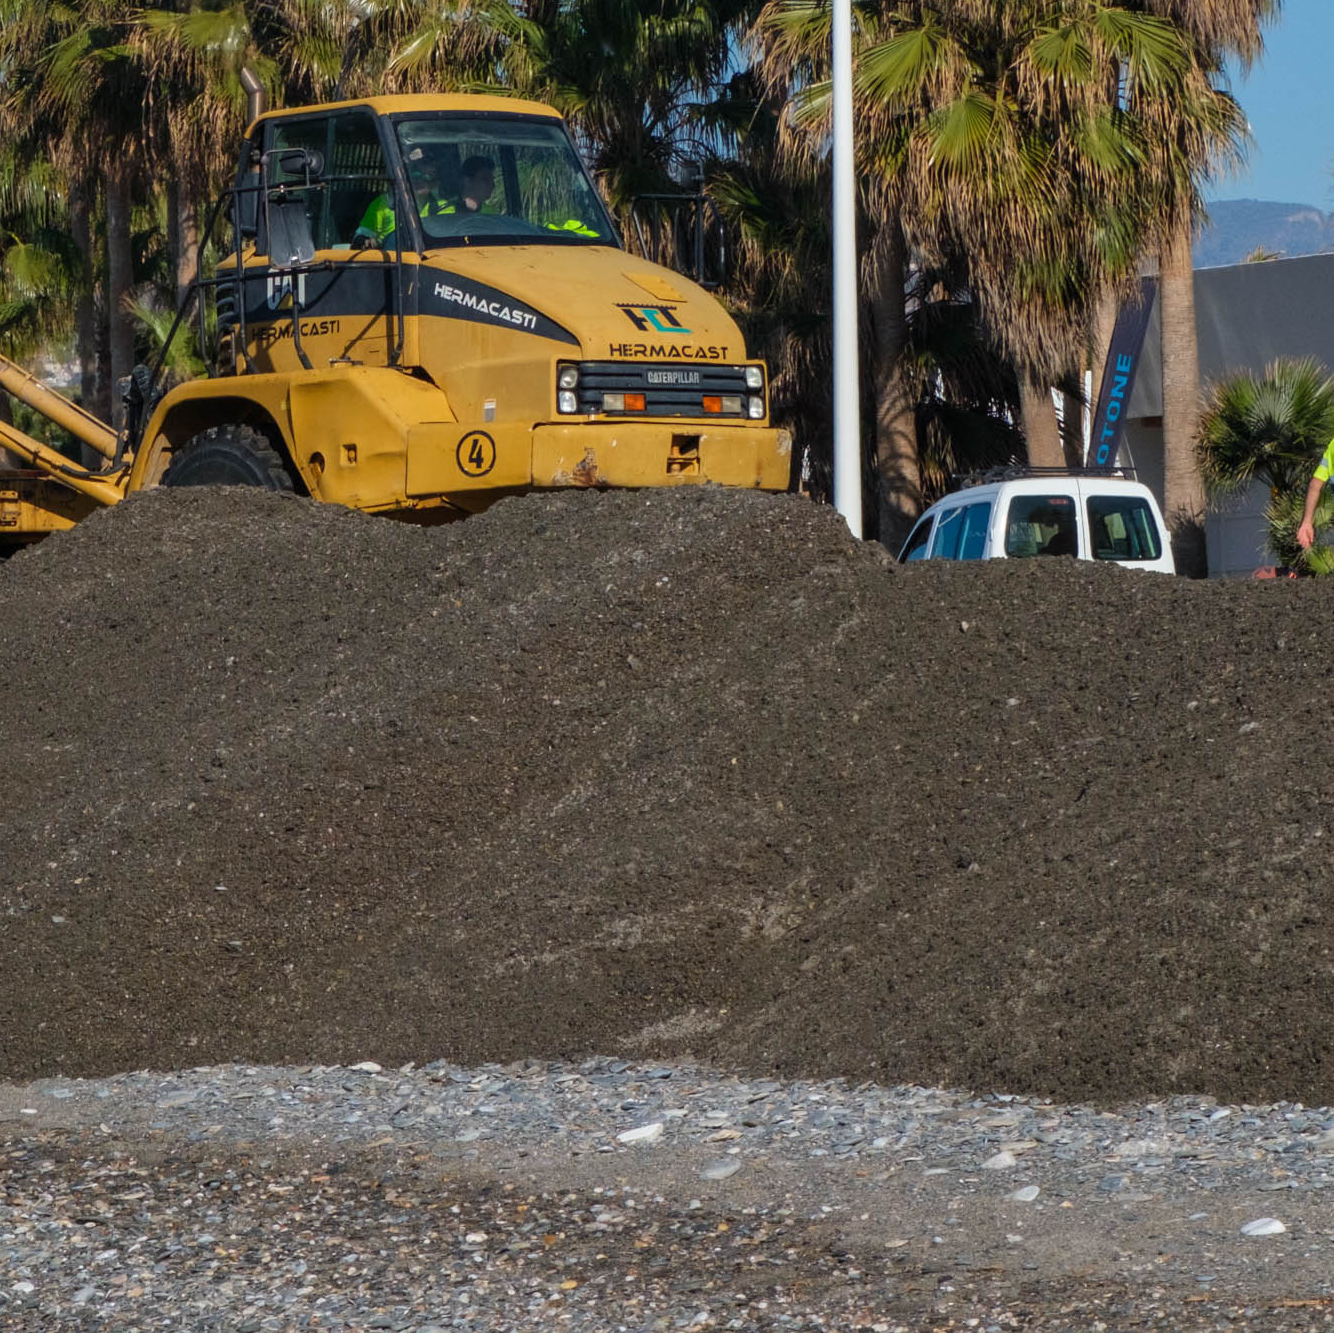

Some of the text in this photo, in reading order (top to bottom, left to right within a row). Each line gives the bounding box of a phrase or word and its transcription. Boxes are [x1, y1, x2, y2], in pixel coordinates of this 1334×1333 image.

[267, 267, 308, 311] CAT
[433, 282, 537, 330] HERMACASTI
[609, 343, 729, 360] HERMACAST
[647, 370, 700, 384] CATERPILLAR
[468, 438, 484, 469] 4
